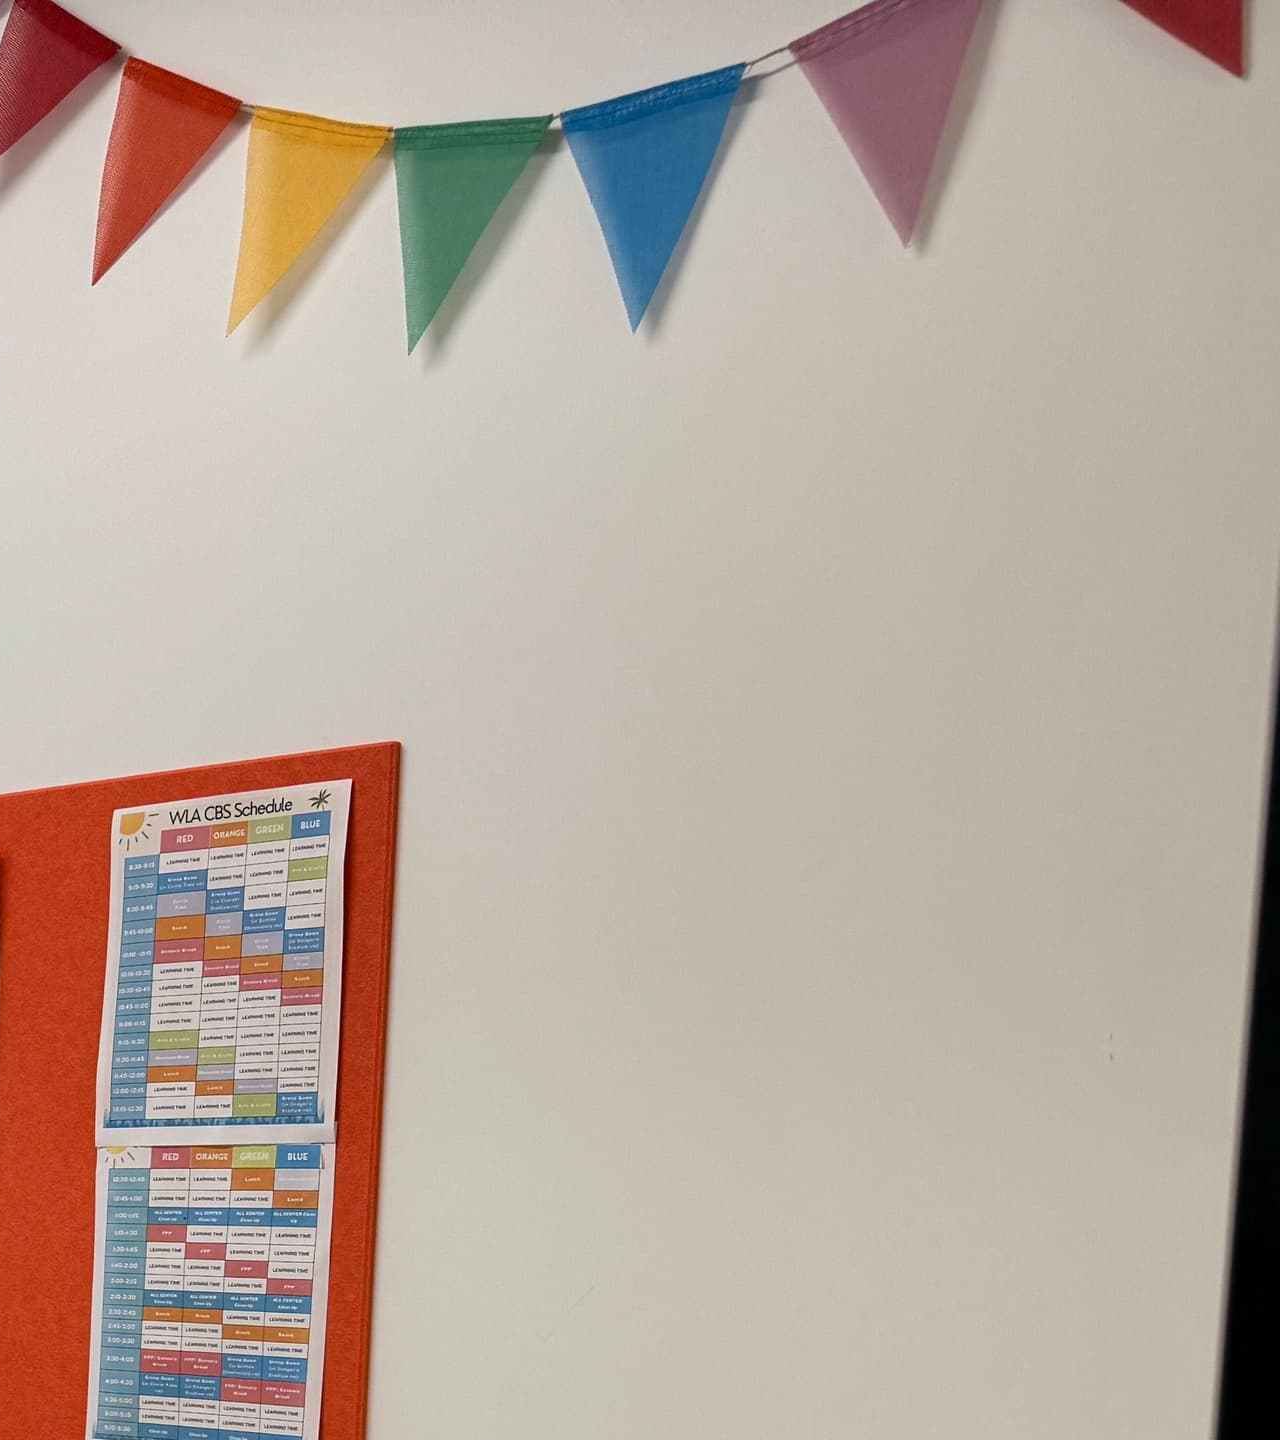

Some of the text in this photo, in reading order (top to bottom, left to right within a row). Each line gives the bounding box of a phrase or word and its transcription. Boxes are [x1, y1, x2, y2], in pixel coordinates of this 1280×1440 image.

[169, 797, 293, 824] WLA CBS Schedule
[256, 823, 284, 834] GREEN
[301, 820, 320, 829] BLUE
[177, 834, 193, 843] RED
[214, 829, 245, 839] ORANGE
[240, 1152, 268, 1160] GREEN
